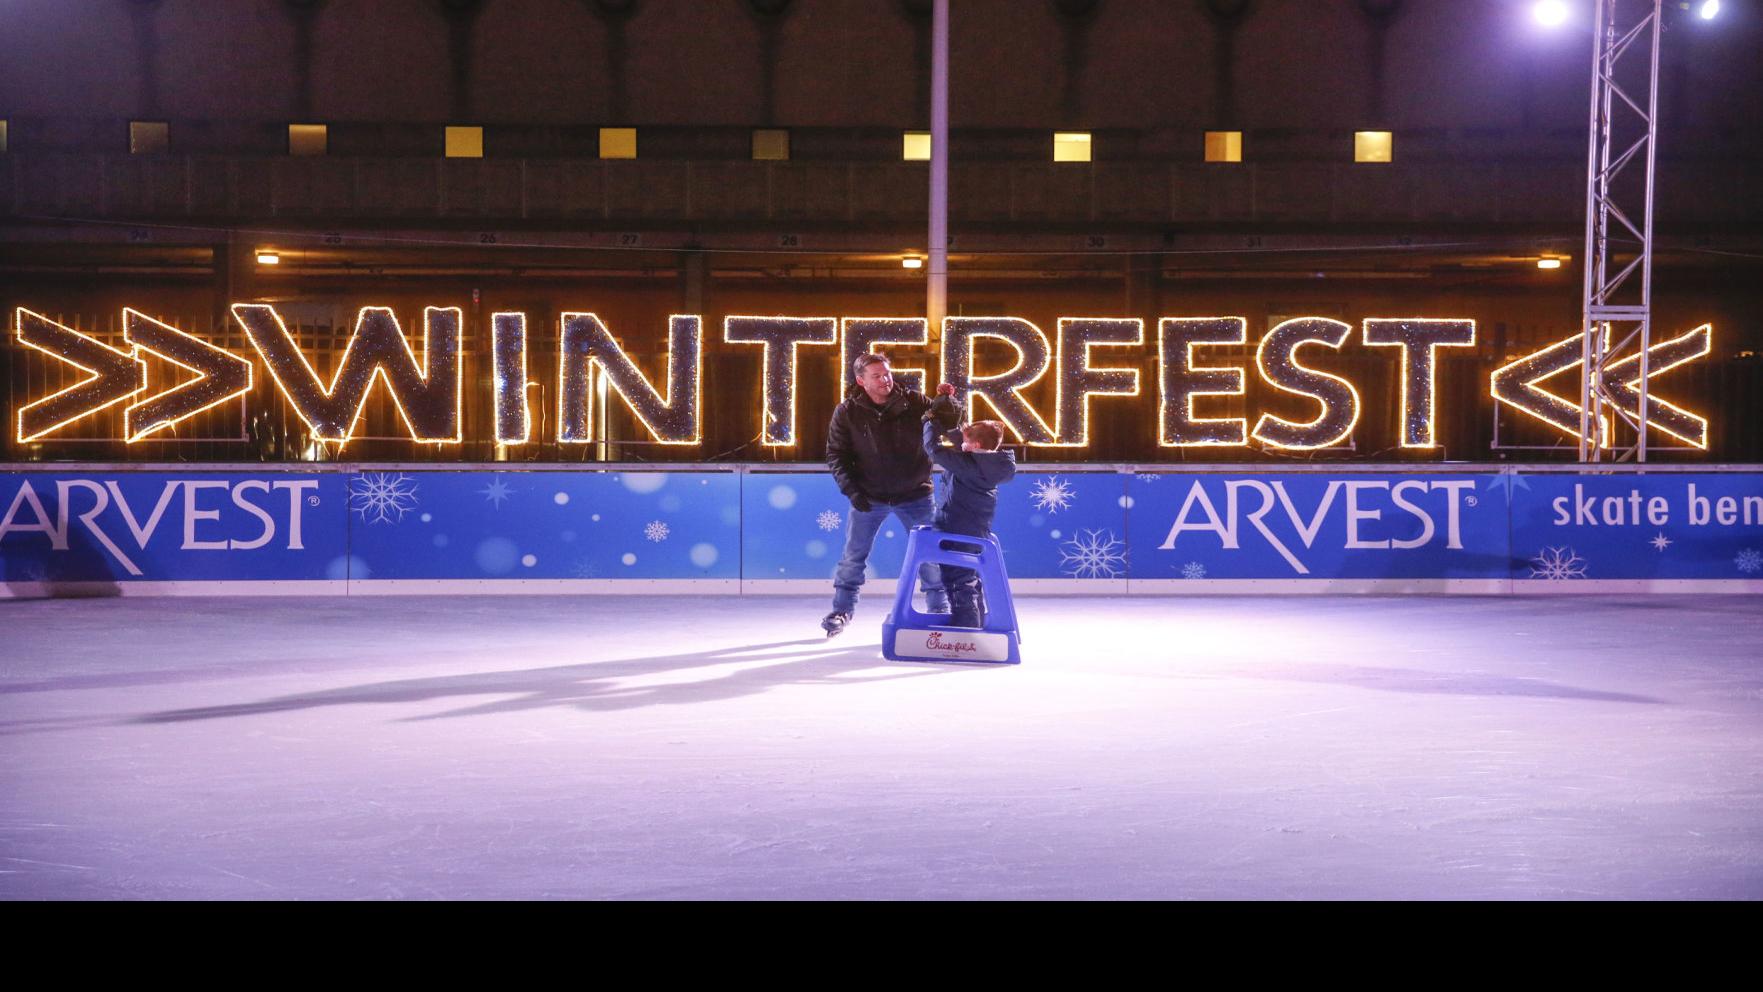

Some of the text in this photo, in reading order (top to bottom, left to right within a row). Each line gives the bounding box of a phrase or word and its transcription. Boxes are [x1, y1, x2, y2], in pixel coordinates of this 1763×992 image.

[480, 233, 496, 244] 26
[622, 234, 638, 245] 27
[782, 235, 798, 246] 28
[1088, 236, 1104, 247] 30
[1248, 237, 1261, 248] 31
[1552, 483, 1763, 526] skate ben
